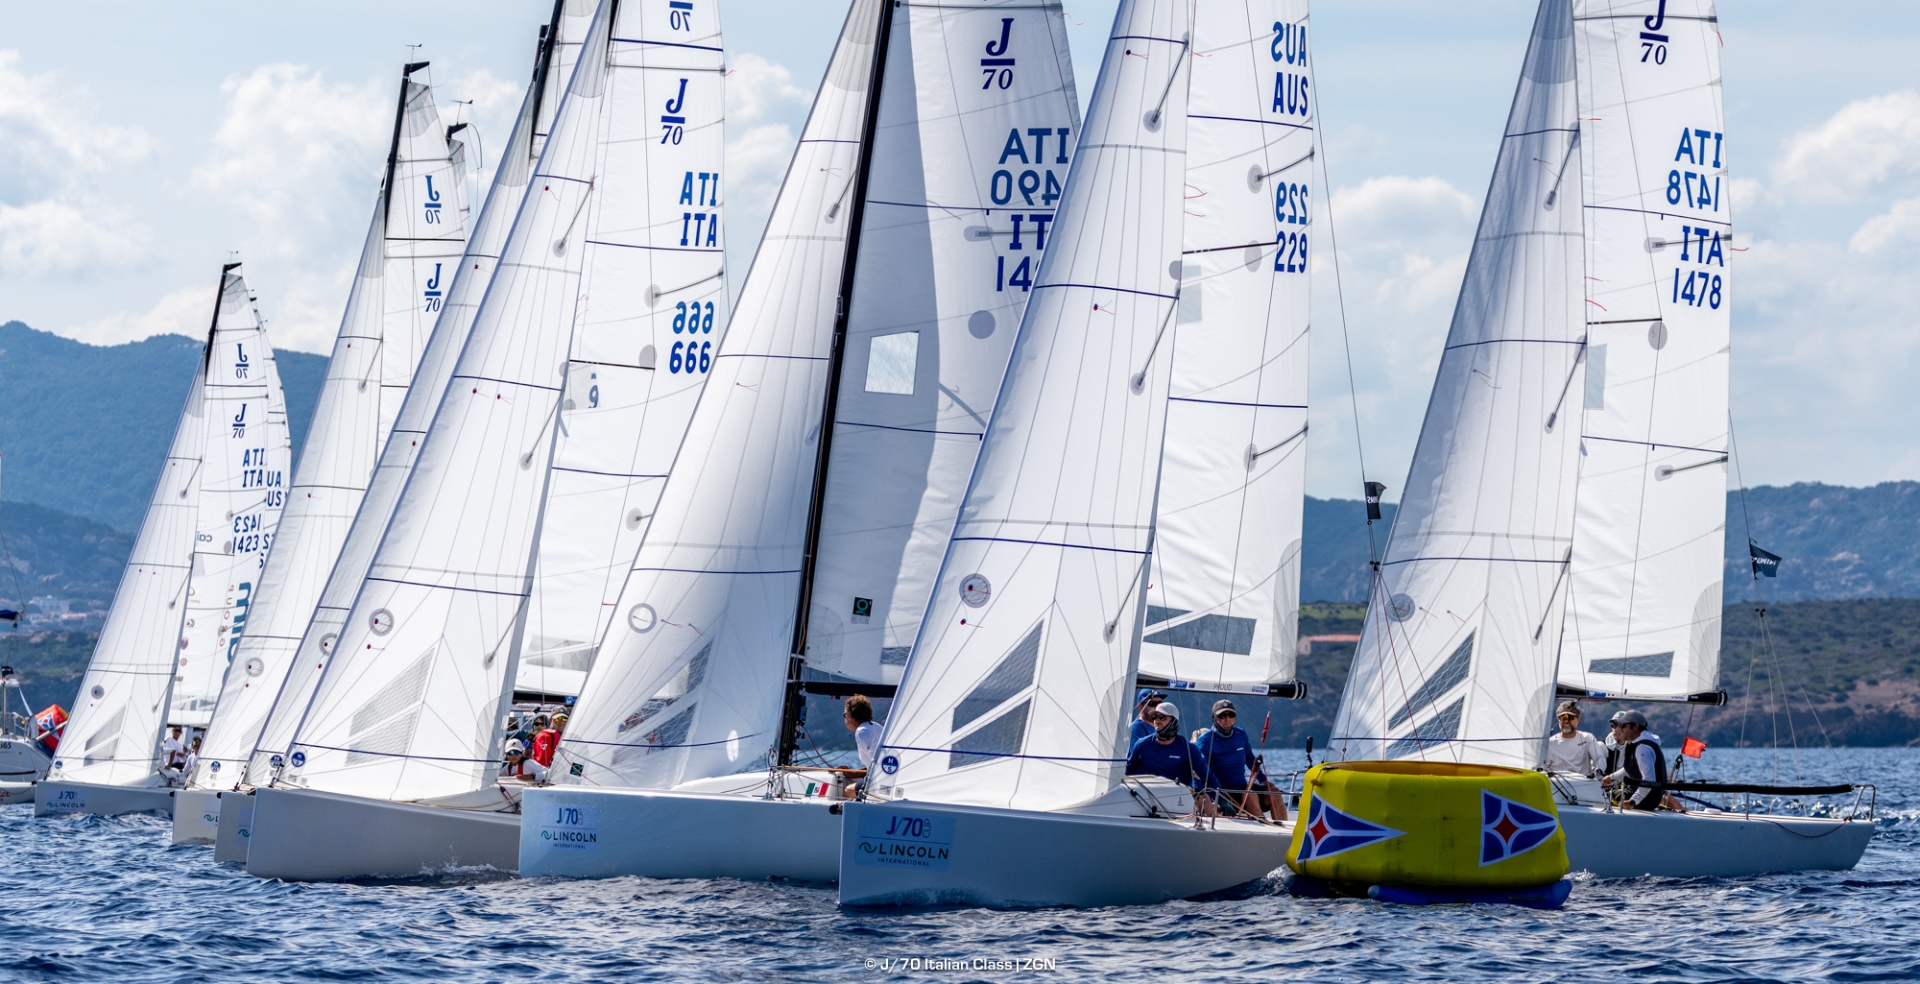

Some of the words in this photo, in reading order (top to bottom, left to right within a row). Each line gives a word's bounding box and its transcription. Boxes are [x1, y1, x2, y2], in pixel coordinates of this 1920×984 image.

[985, 18, 1014, 57] J
[1640, 42, 1668, 65] 70
[982, 69, 1014, 90] 70
[665, 78, 689, 114] J
[1272, 72, 1309, 117] AUS
[660, 125, 683, 146] 70
[680, 213, 717, 247] ITA
[1009, 214, 1054, 250] IT
[1274, 231, 1307, 273] 229
[1680, 225, 1724, 267] ITA
[427, 263, 442, 290] J
[996, 256, 1042, 292] 14
[1672, 267, 1722, 310] 1478
[425, 297, 441, 312] 70
[669, 341, 711, 374] 666
[235, 403, 247, 422] J
[232, 428, 245, 439] 70
[242, 469, 263, 488] ITA
[232, 534, 259, 554] 1423
[553, 831, 597, 843] LINCOLN
[886, 816, 923, 837] J/70
[877, 857, 930, 867] INTERNATIONAL
[879, 843, 949, 860] LINCOLN
